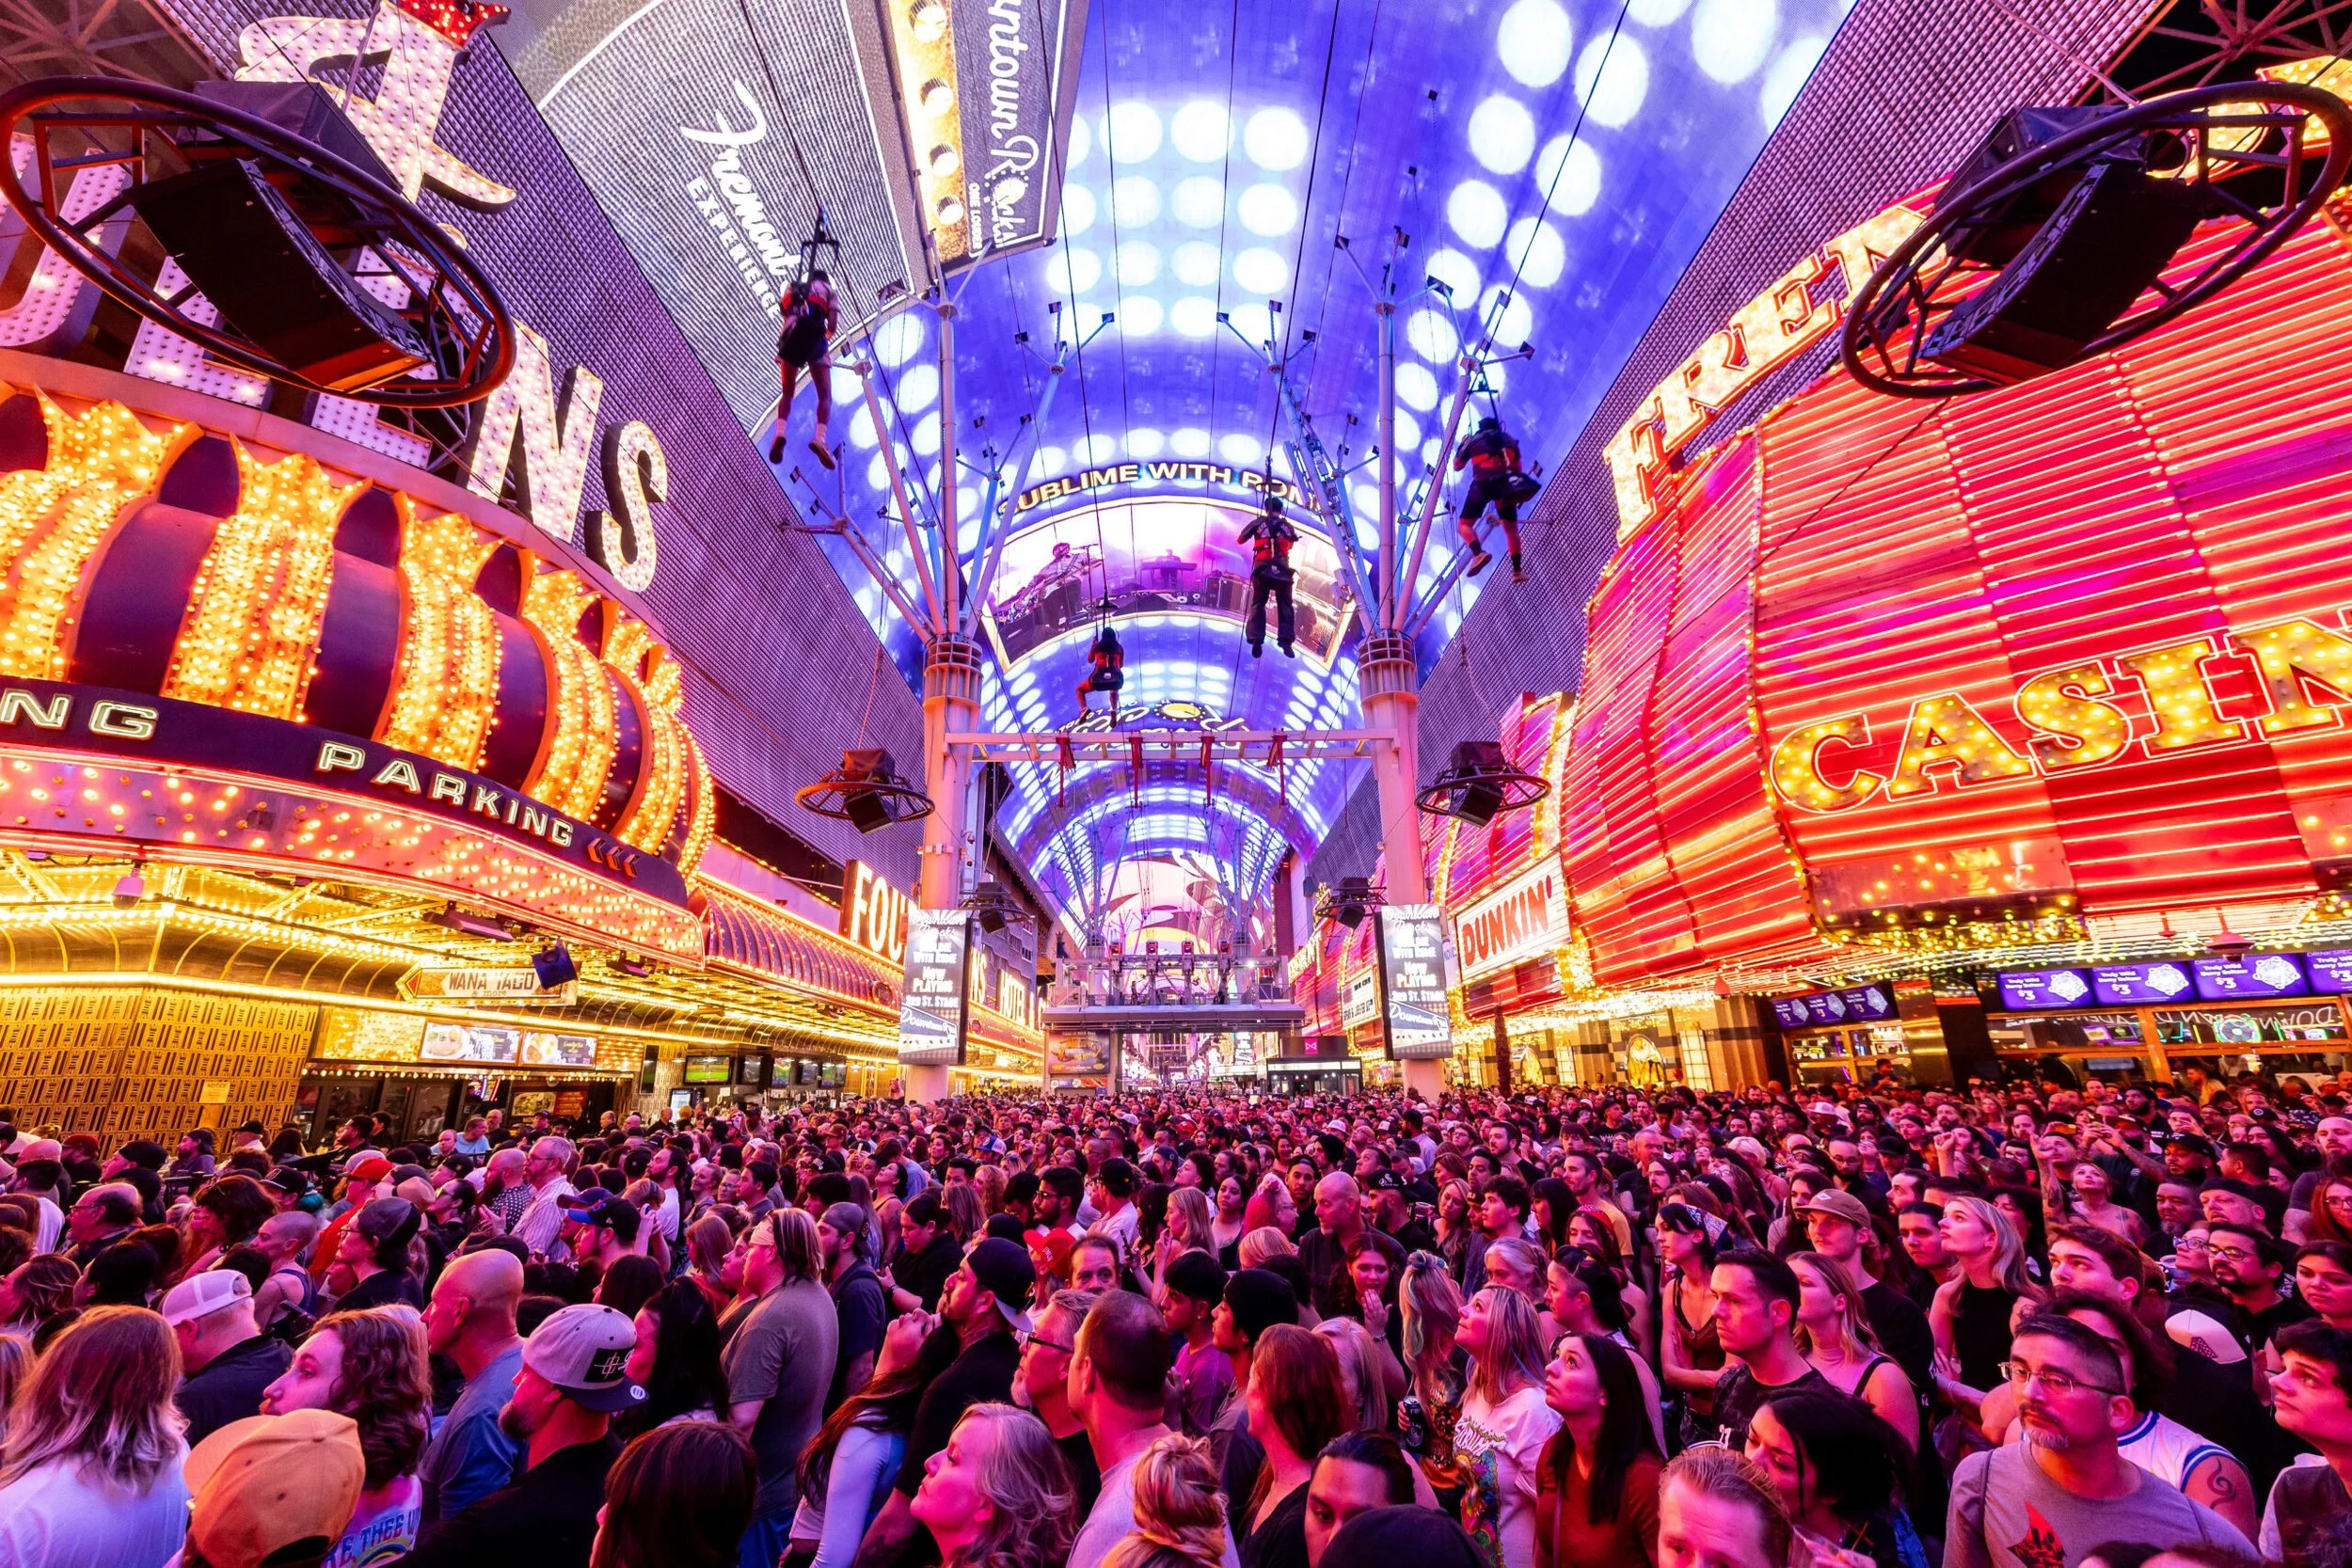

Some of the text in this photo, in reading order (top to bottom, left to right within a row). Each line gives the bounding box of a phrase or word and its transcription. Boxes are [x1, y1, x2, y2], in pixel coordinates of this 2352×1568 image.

[1149, 463, 1232, 485] WITH
[1242, 470, 1321, 513] ROM
[314, 739, 575, 847] PARKING
[850, 860, 918, 963] FOU
[1462, 874, 1552, 967] DUNKIN'
[449, 972, 487, 990] WANA
[2111, 983, 2132, 995] $3
[2215, 976, 2237, 989] $3
[2329, 969, 2352, 982] $3
[2017, 989, 2037, 1001] $3
[360, 1513, 405, 1553] THEE
